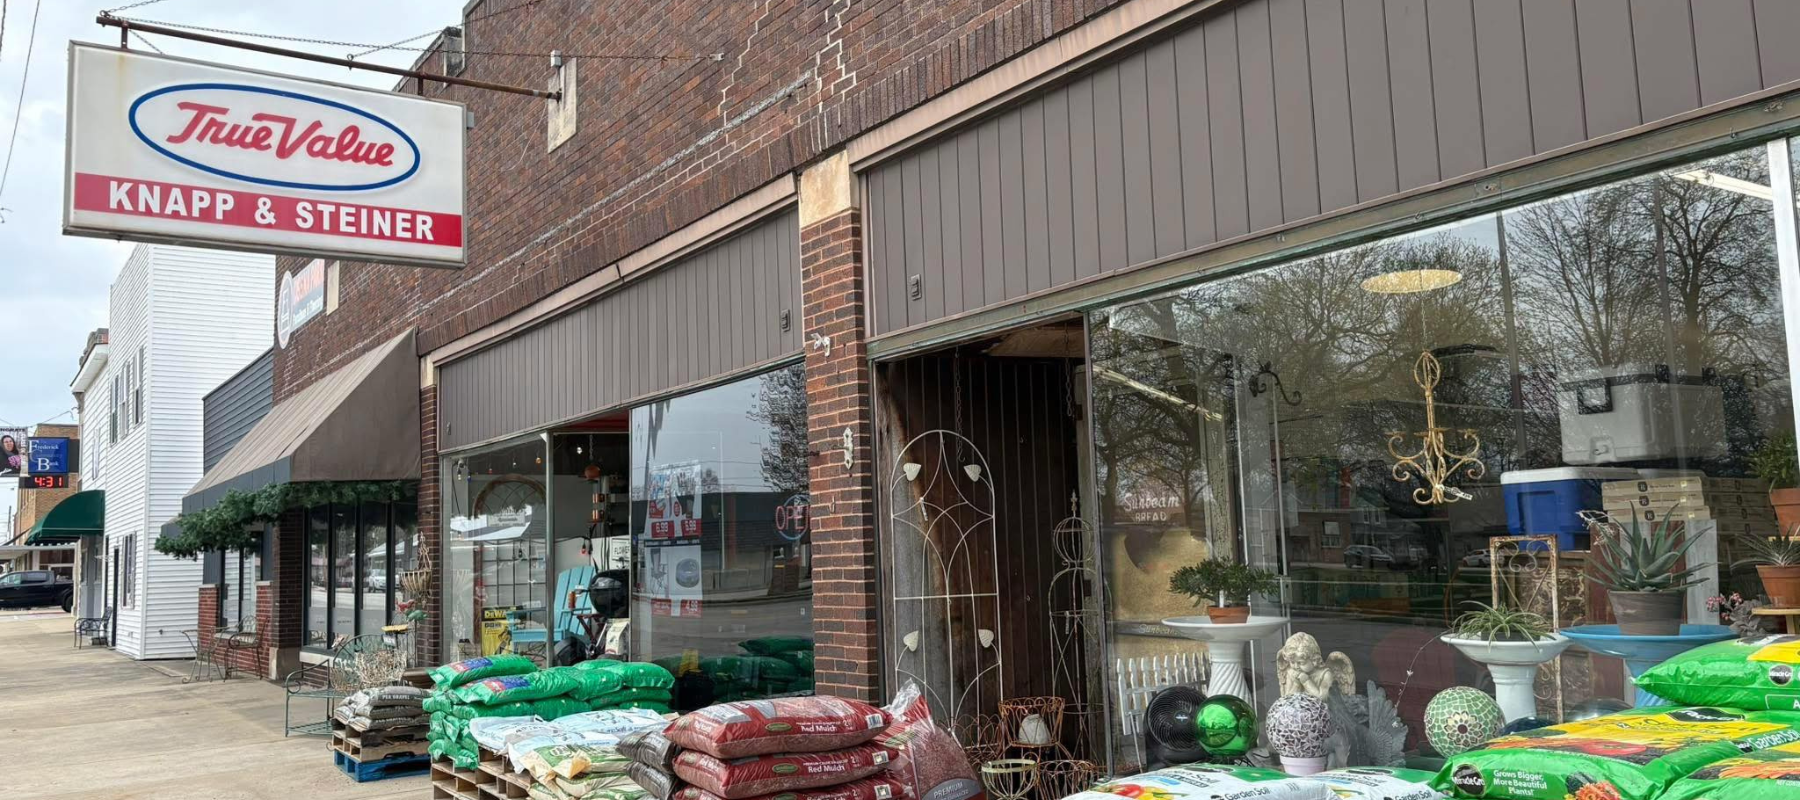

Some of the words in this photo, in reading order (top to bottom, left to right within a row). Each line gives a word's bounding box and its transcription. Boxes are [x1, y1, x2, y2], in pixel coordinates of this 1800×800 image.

[109, 180, 235, 220] KNAPP
[254, 197, 276, 225] &
[295, 201, 435, 241] STEINER
[29, 440, 59, 453] Frederick
[34, 476, 64, 488] 4:31
[1123, 493, 1180, 511] Sunbeam
[1135, 511, 1167, 522] BREAD
[801, 724, 815, 732] Red
[816, 724, 837, 732] Mulch
[823, 764, 845, 772] Mulch
[1493, 770, 1517, 778] Grows
[1493, 778, 1512, 786] More
[1513, 779, 1548, 789] Beautiful
[1254, 787, 1271, 796] Soil
